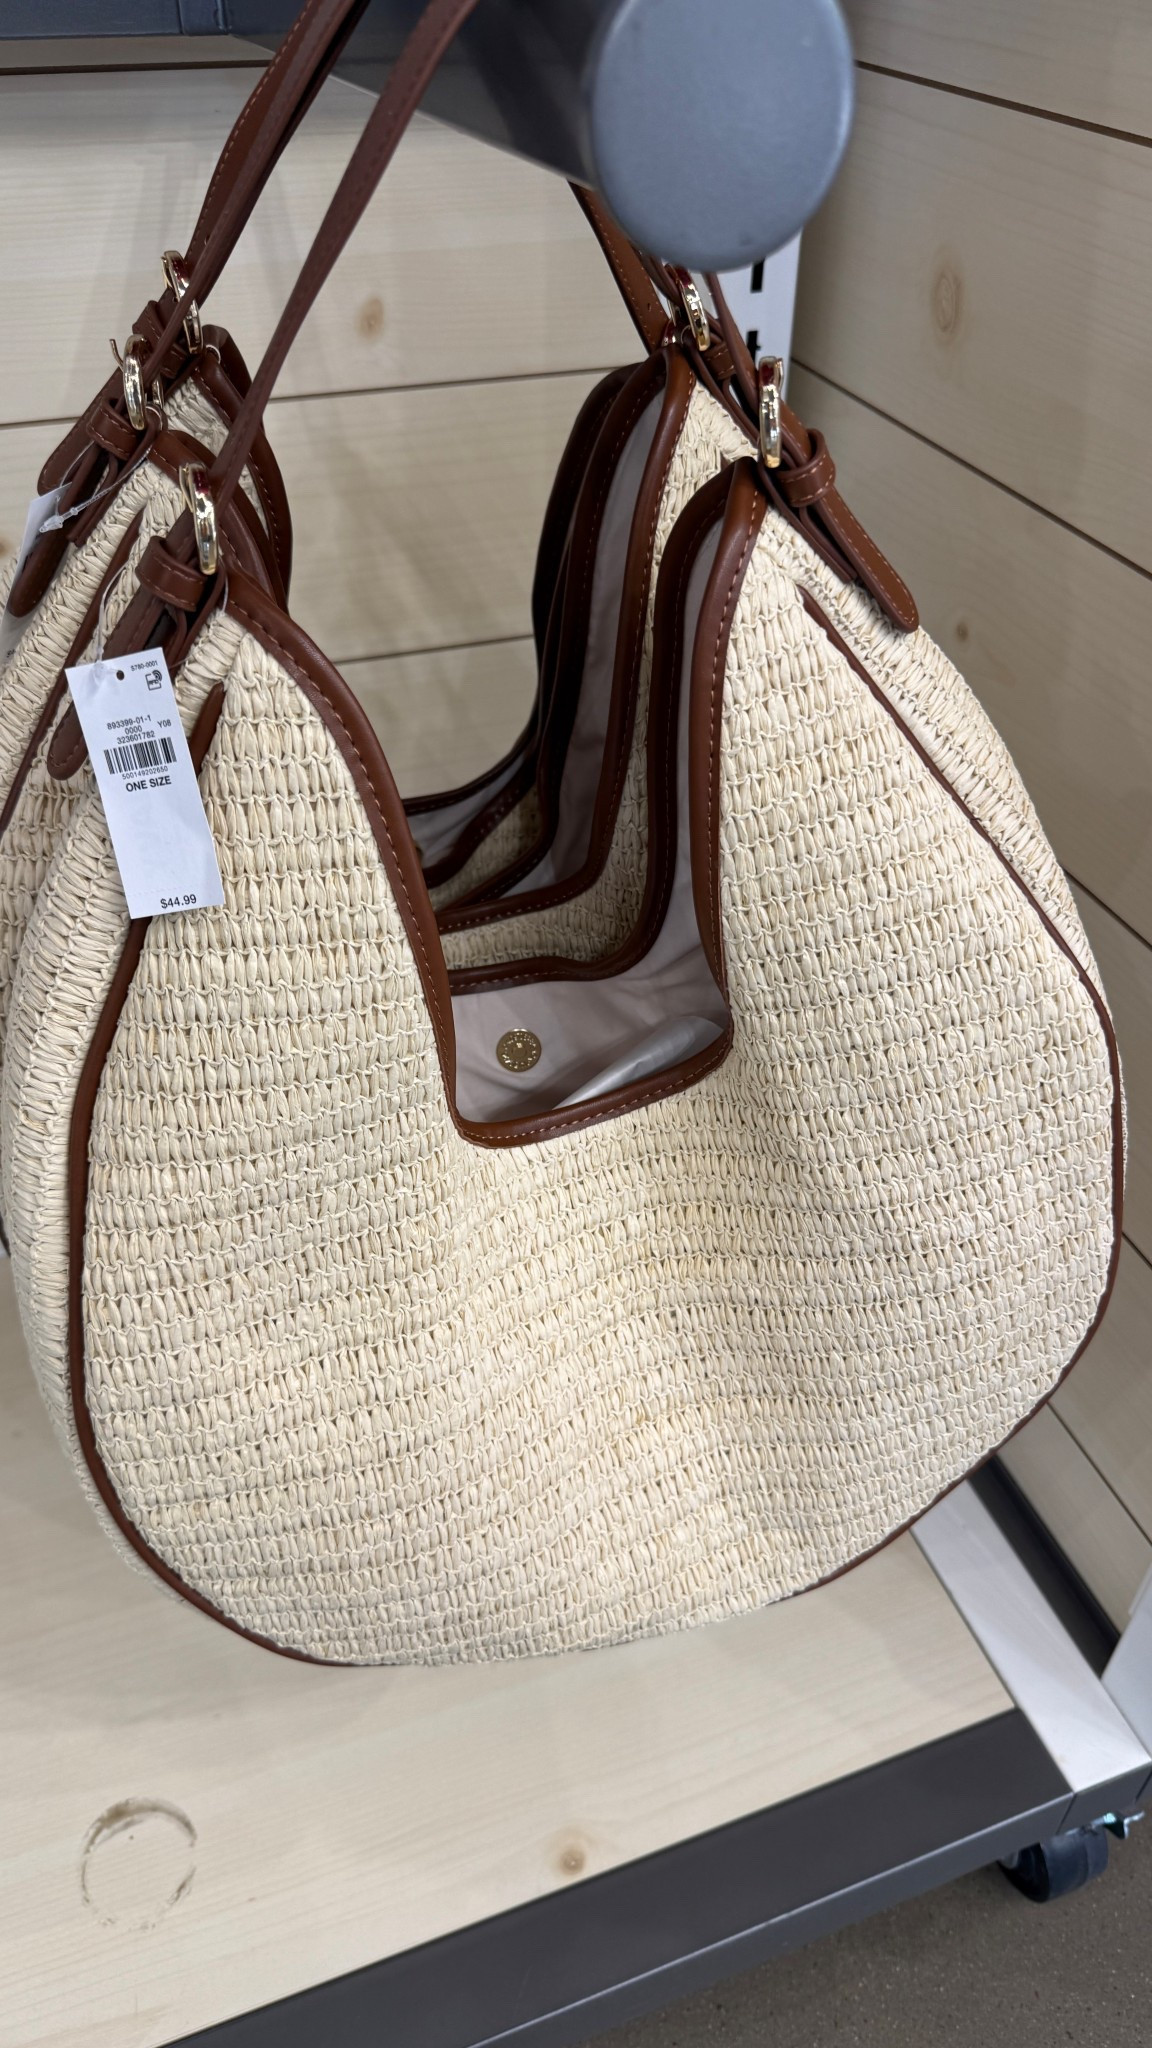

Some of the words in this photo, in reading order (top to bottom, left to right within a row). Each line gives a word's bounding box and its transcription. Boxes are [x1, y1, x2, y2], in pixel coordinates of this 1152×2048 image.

[107, 715, 151, 729] 893399-01-1
[157, 719, 172, 728] Y08
[125, 725, 142, 735] 0000
[122, 766, 168, 780] 500149202650
[126, 780, 148, 792] ONE
[149, 776, 171, 787] SIZE
[160, 894, 197, 909] $44.99
